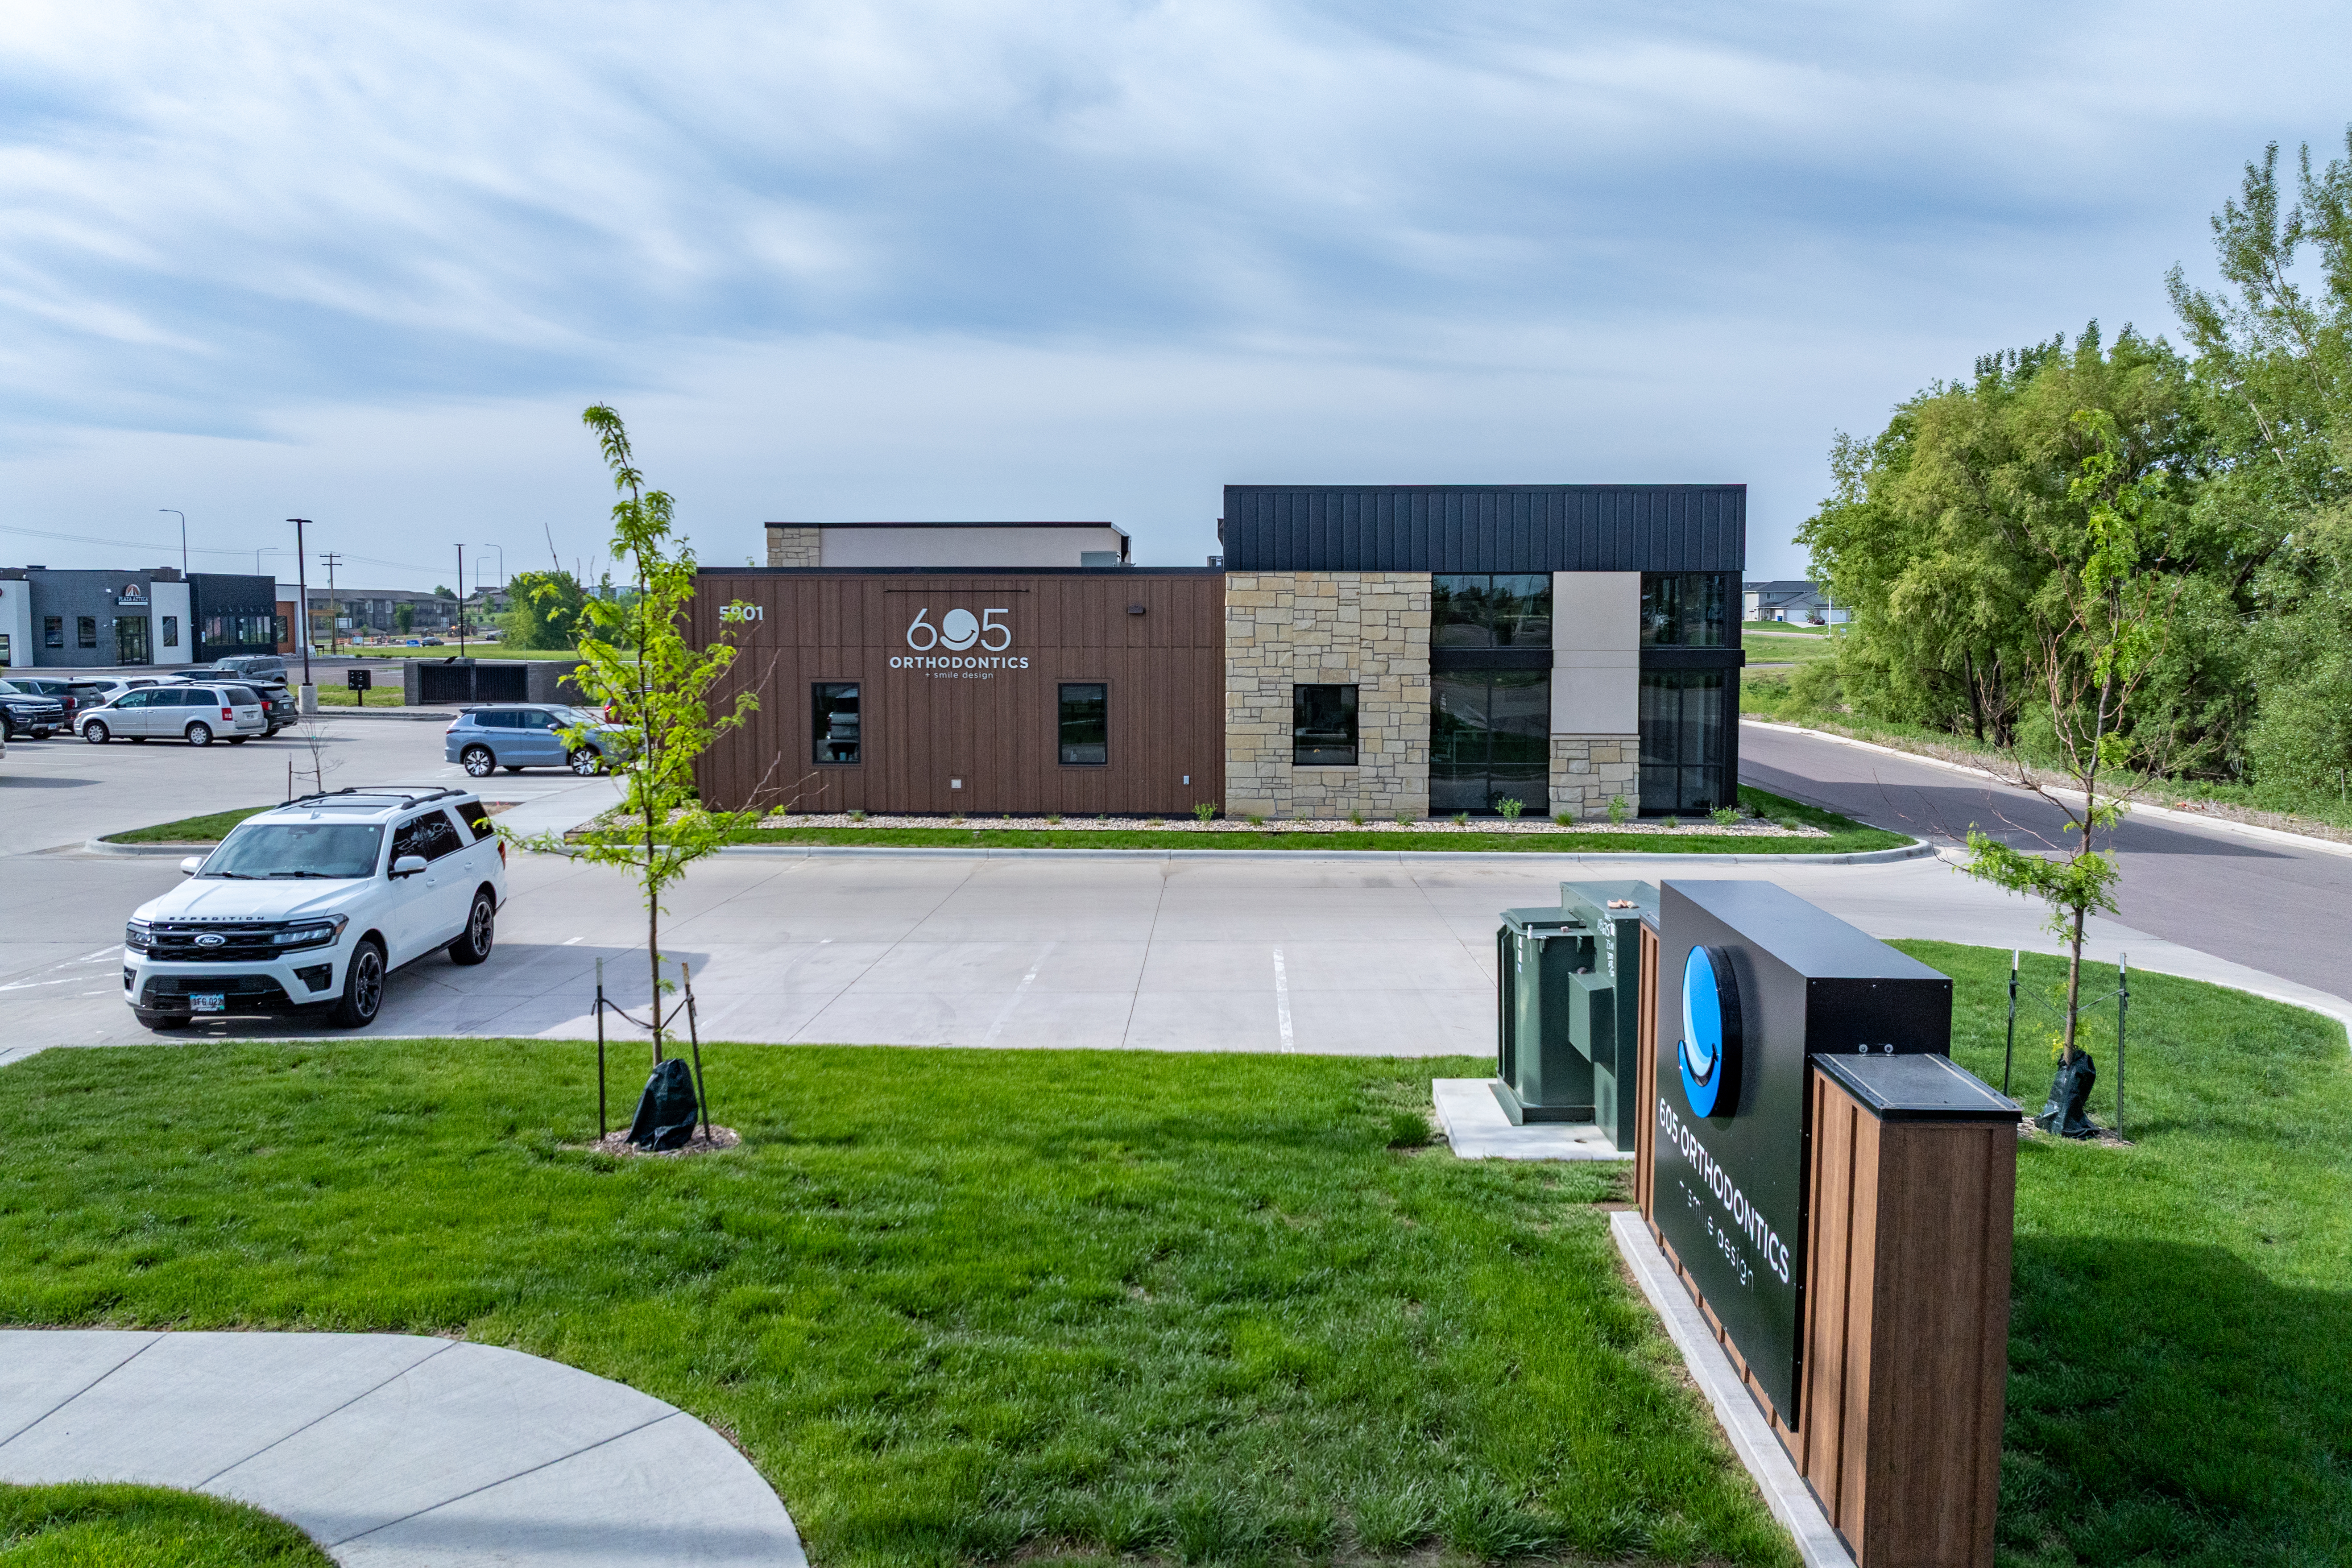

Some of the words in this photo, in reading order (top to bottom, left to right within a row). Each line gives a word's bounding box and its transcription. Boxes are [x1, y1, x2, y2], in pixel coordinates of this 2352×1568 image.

[719, 606, 763, 621] 5901
[890, 657, 1029, 669] ORTHODONTICS
[962, 671, 993, 679] design
[1660, 1098, 1678, 1143] 605
[1681, 1125, 1789, 1283] ORTHODONTICS
[1688, 1189, 1713, 1235] smile
[1718, 1227, 1753, 1291] design
